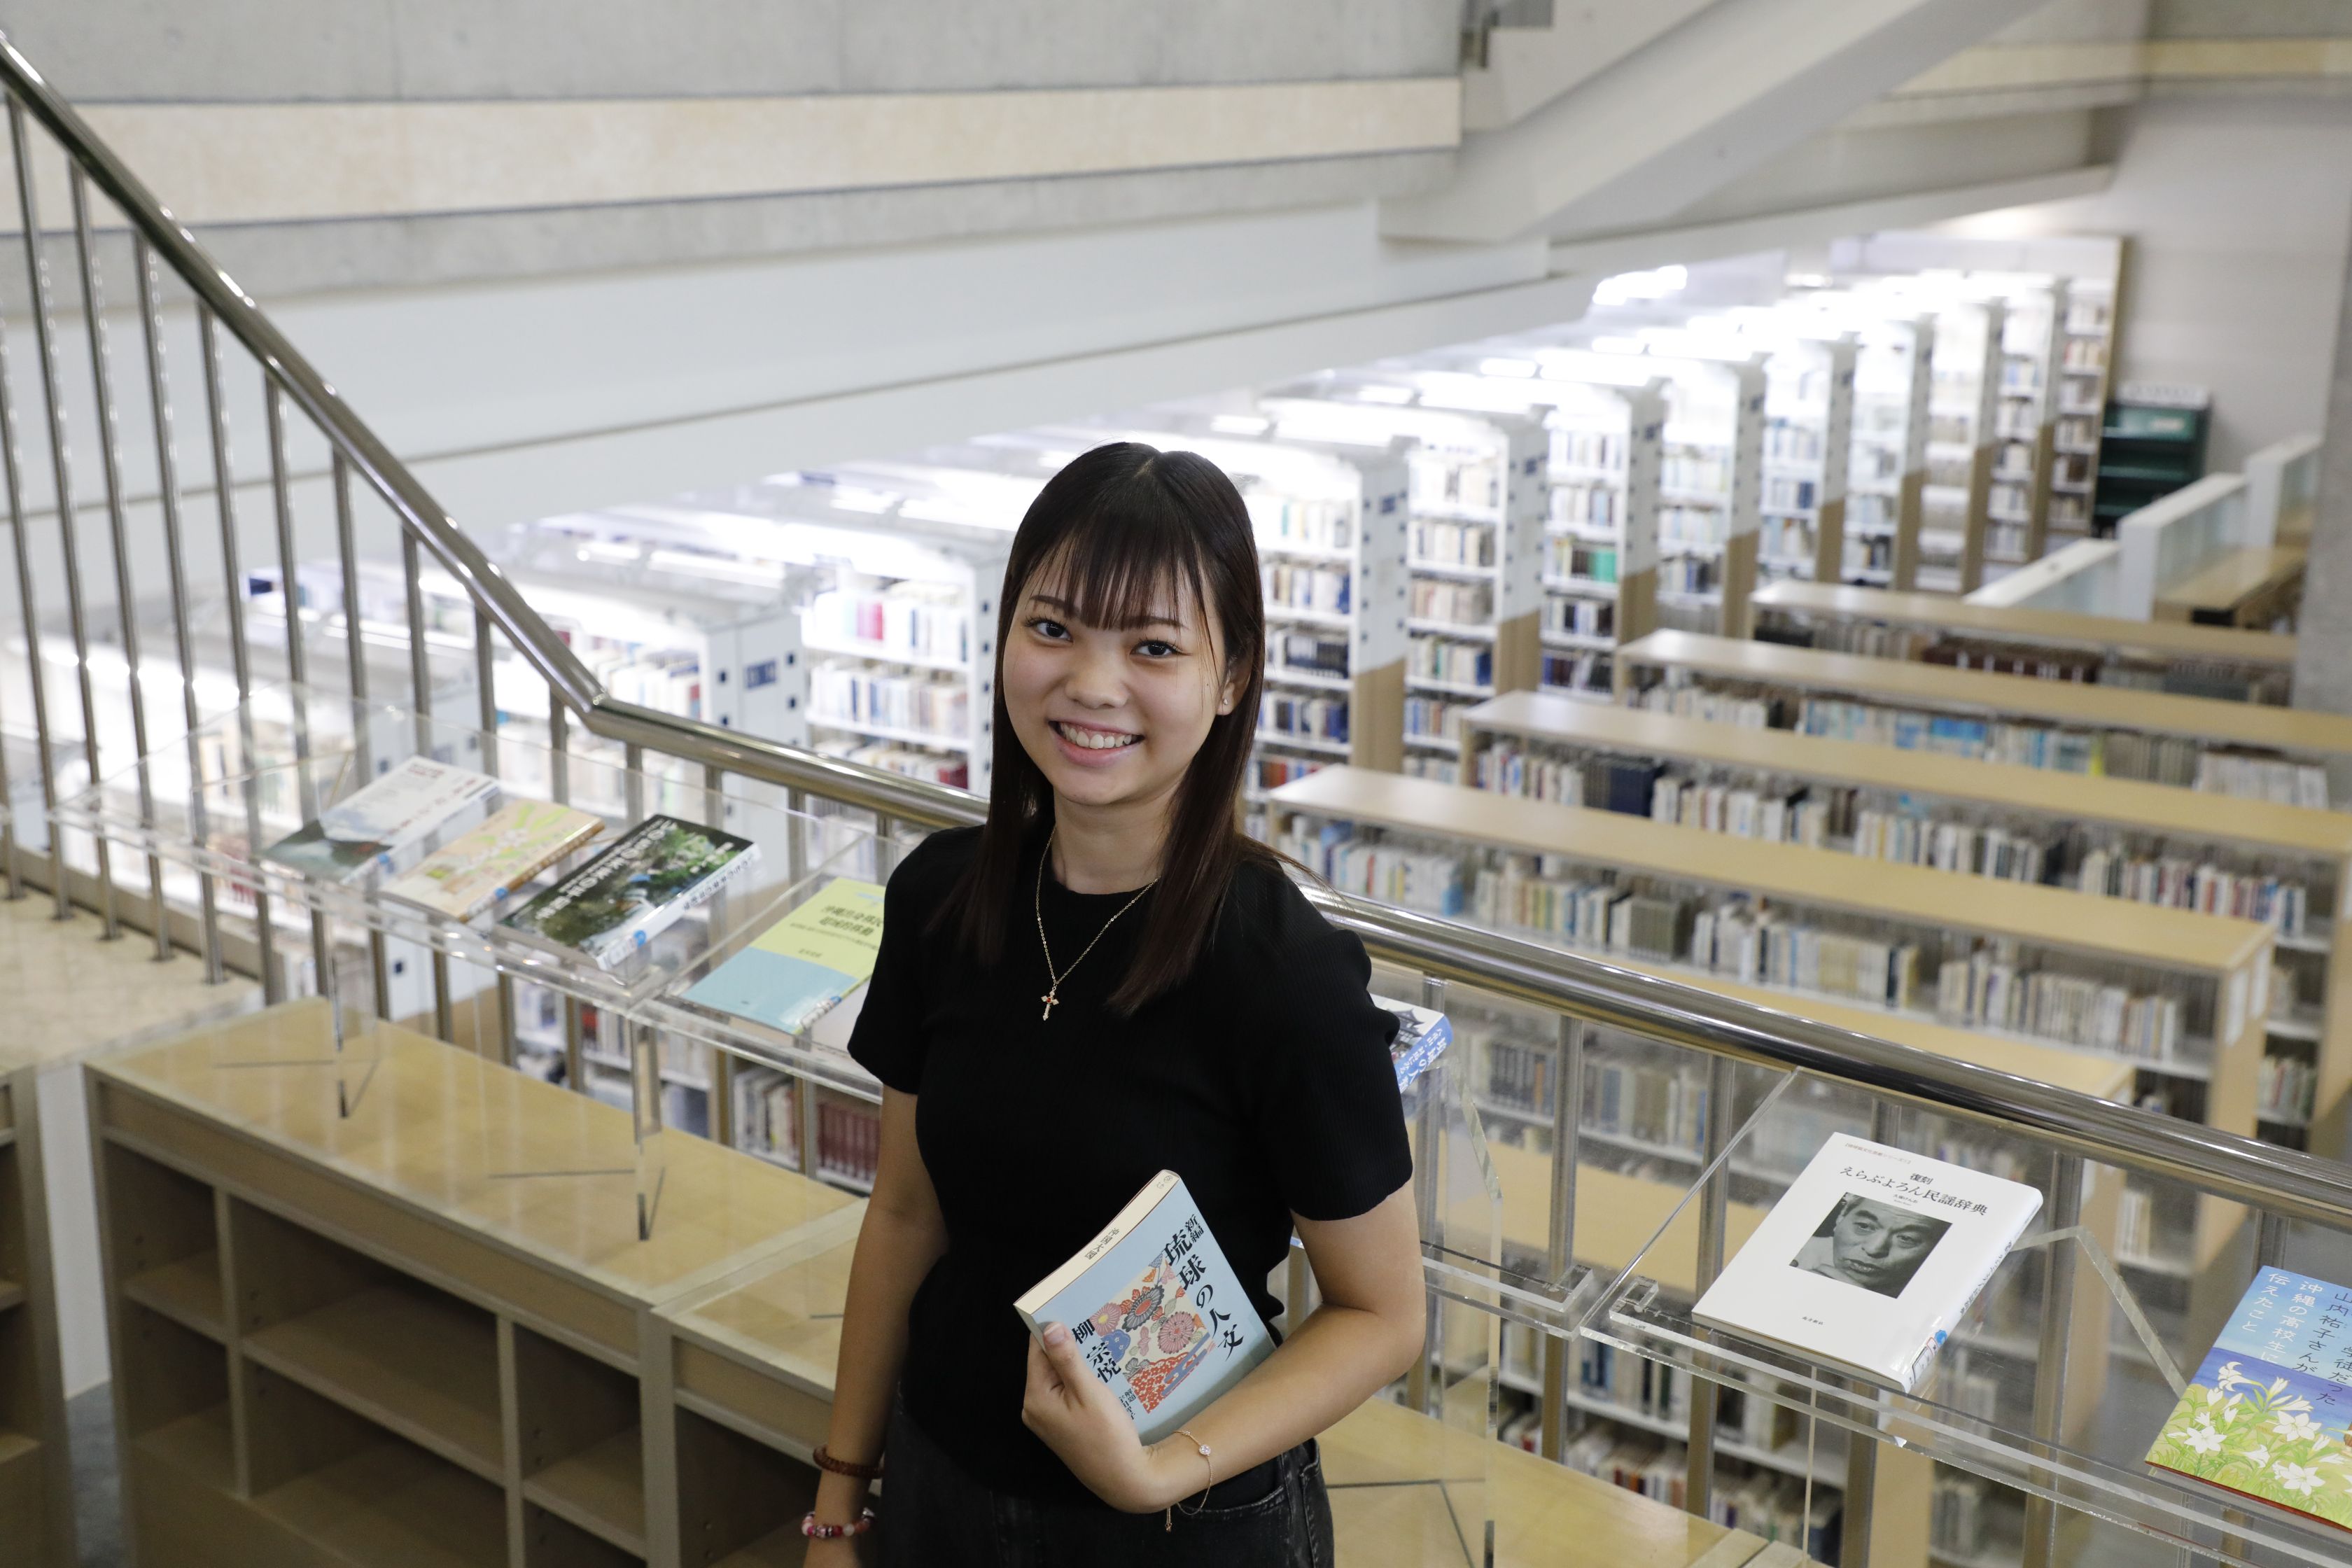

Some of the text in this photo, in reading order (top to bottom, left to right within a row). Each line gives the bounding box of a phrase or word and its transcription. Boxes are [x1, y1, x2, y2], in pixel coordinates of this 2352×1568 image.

[1840, 1166, 1989, 1216] えらぶよろん民謡辞典
[1910, 1172, 1934, 1185] 復刻
[1185, 1214, 1205, 1244] 新編
[1161, 1228, 1245, 1362] 琉球の人文
[2241, 1273, 2291, 1333] 伝えたこと
[2260, 1280, 2324, 1364] 沖縄の高校生に
[1072, 1318, 1122, 1384] 柳宗悦
[2292, 1292, 2352, 1373] 山内祐子さんが
